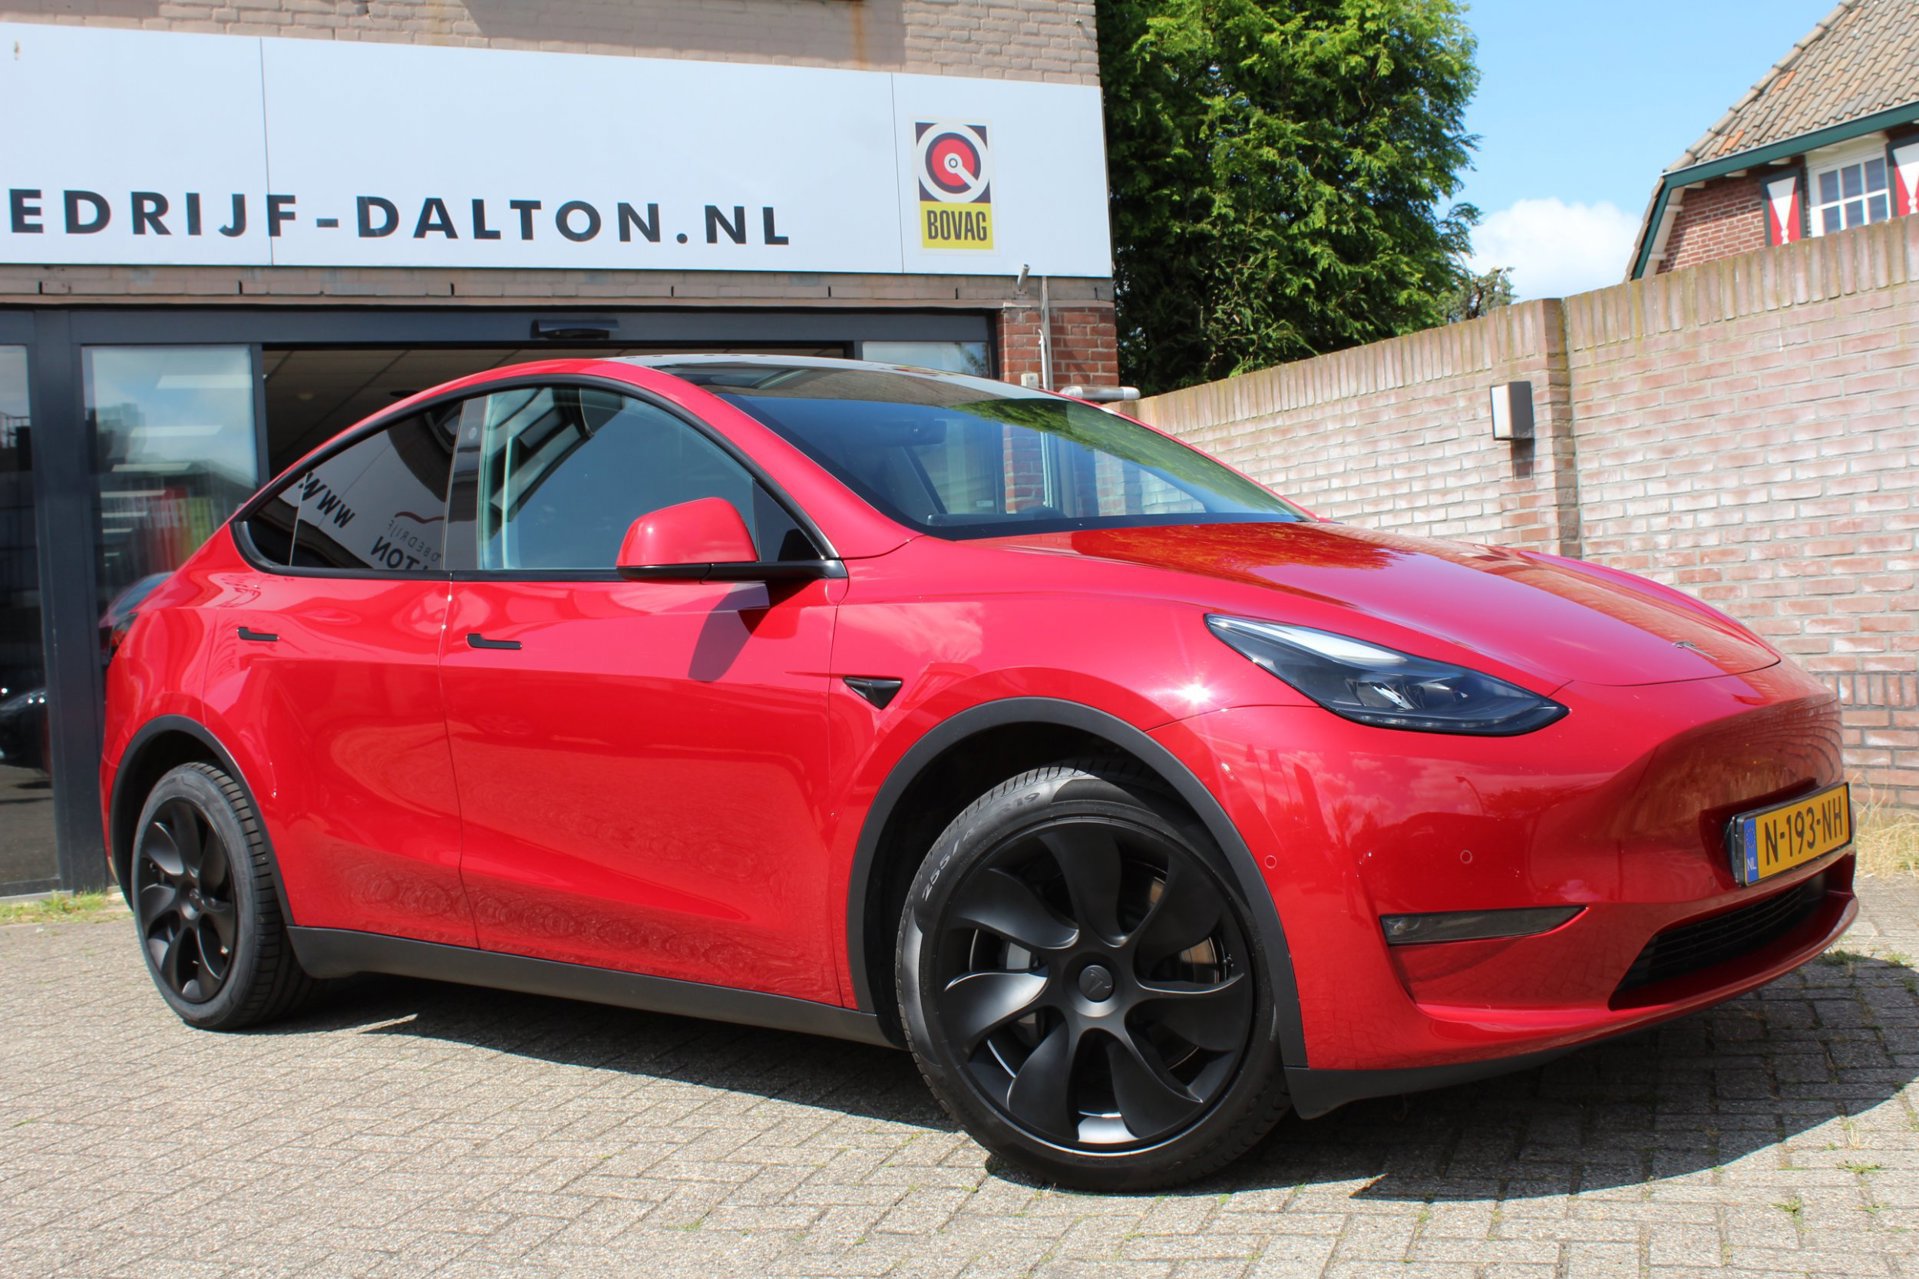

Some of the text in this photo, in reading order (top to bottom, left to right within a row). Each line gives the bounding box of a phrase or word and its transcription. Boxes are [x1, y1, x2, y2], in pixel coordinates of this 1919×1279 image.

[9, 188, 789, 245] EDRIJF-DALTON.NL
[927, 210, 987, 241] BOVAG
[1764, 796, 1843, 866] N-193-NH
[1746, 857, 1757, 871] NL
